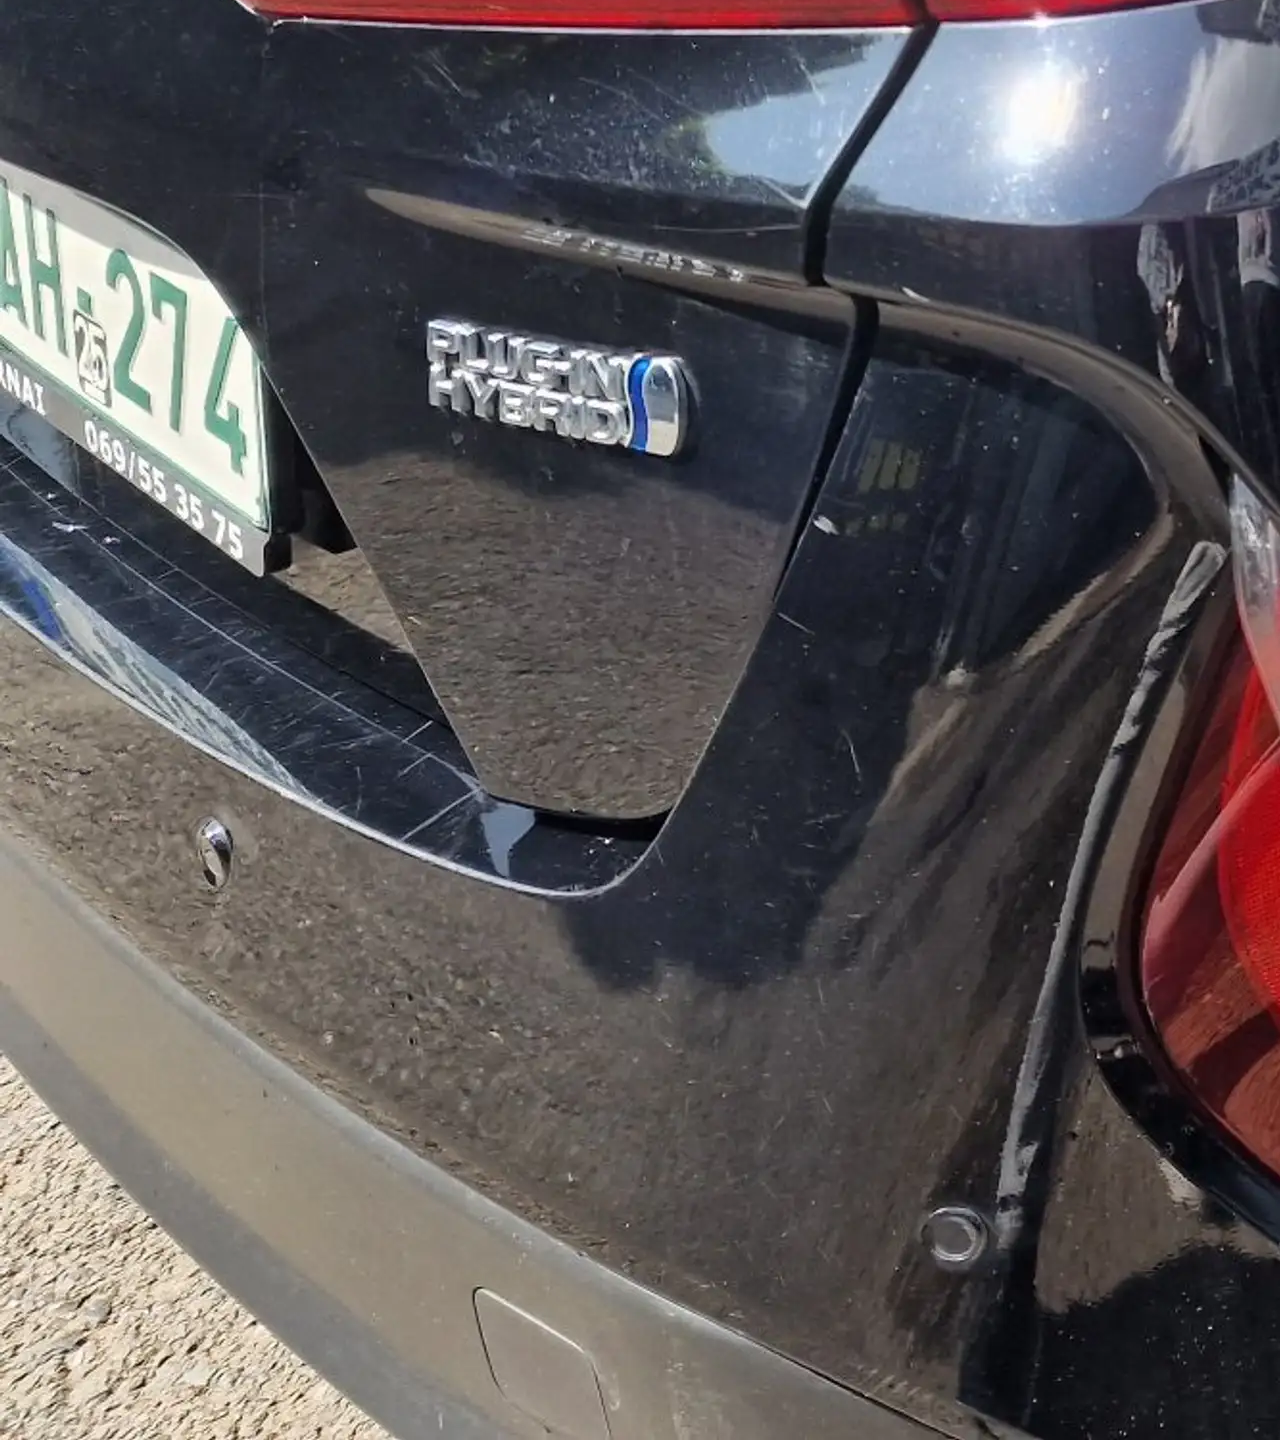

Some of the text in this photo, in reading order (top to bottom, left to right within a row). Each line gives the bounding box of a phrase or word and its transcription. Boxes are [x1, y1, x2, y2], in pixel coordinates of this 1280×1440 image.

[428, 360, 633, 442] HYBRID
[84, 419, 244, 560] 069/55 35 75
